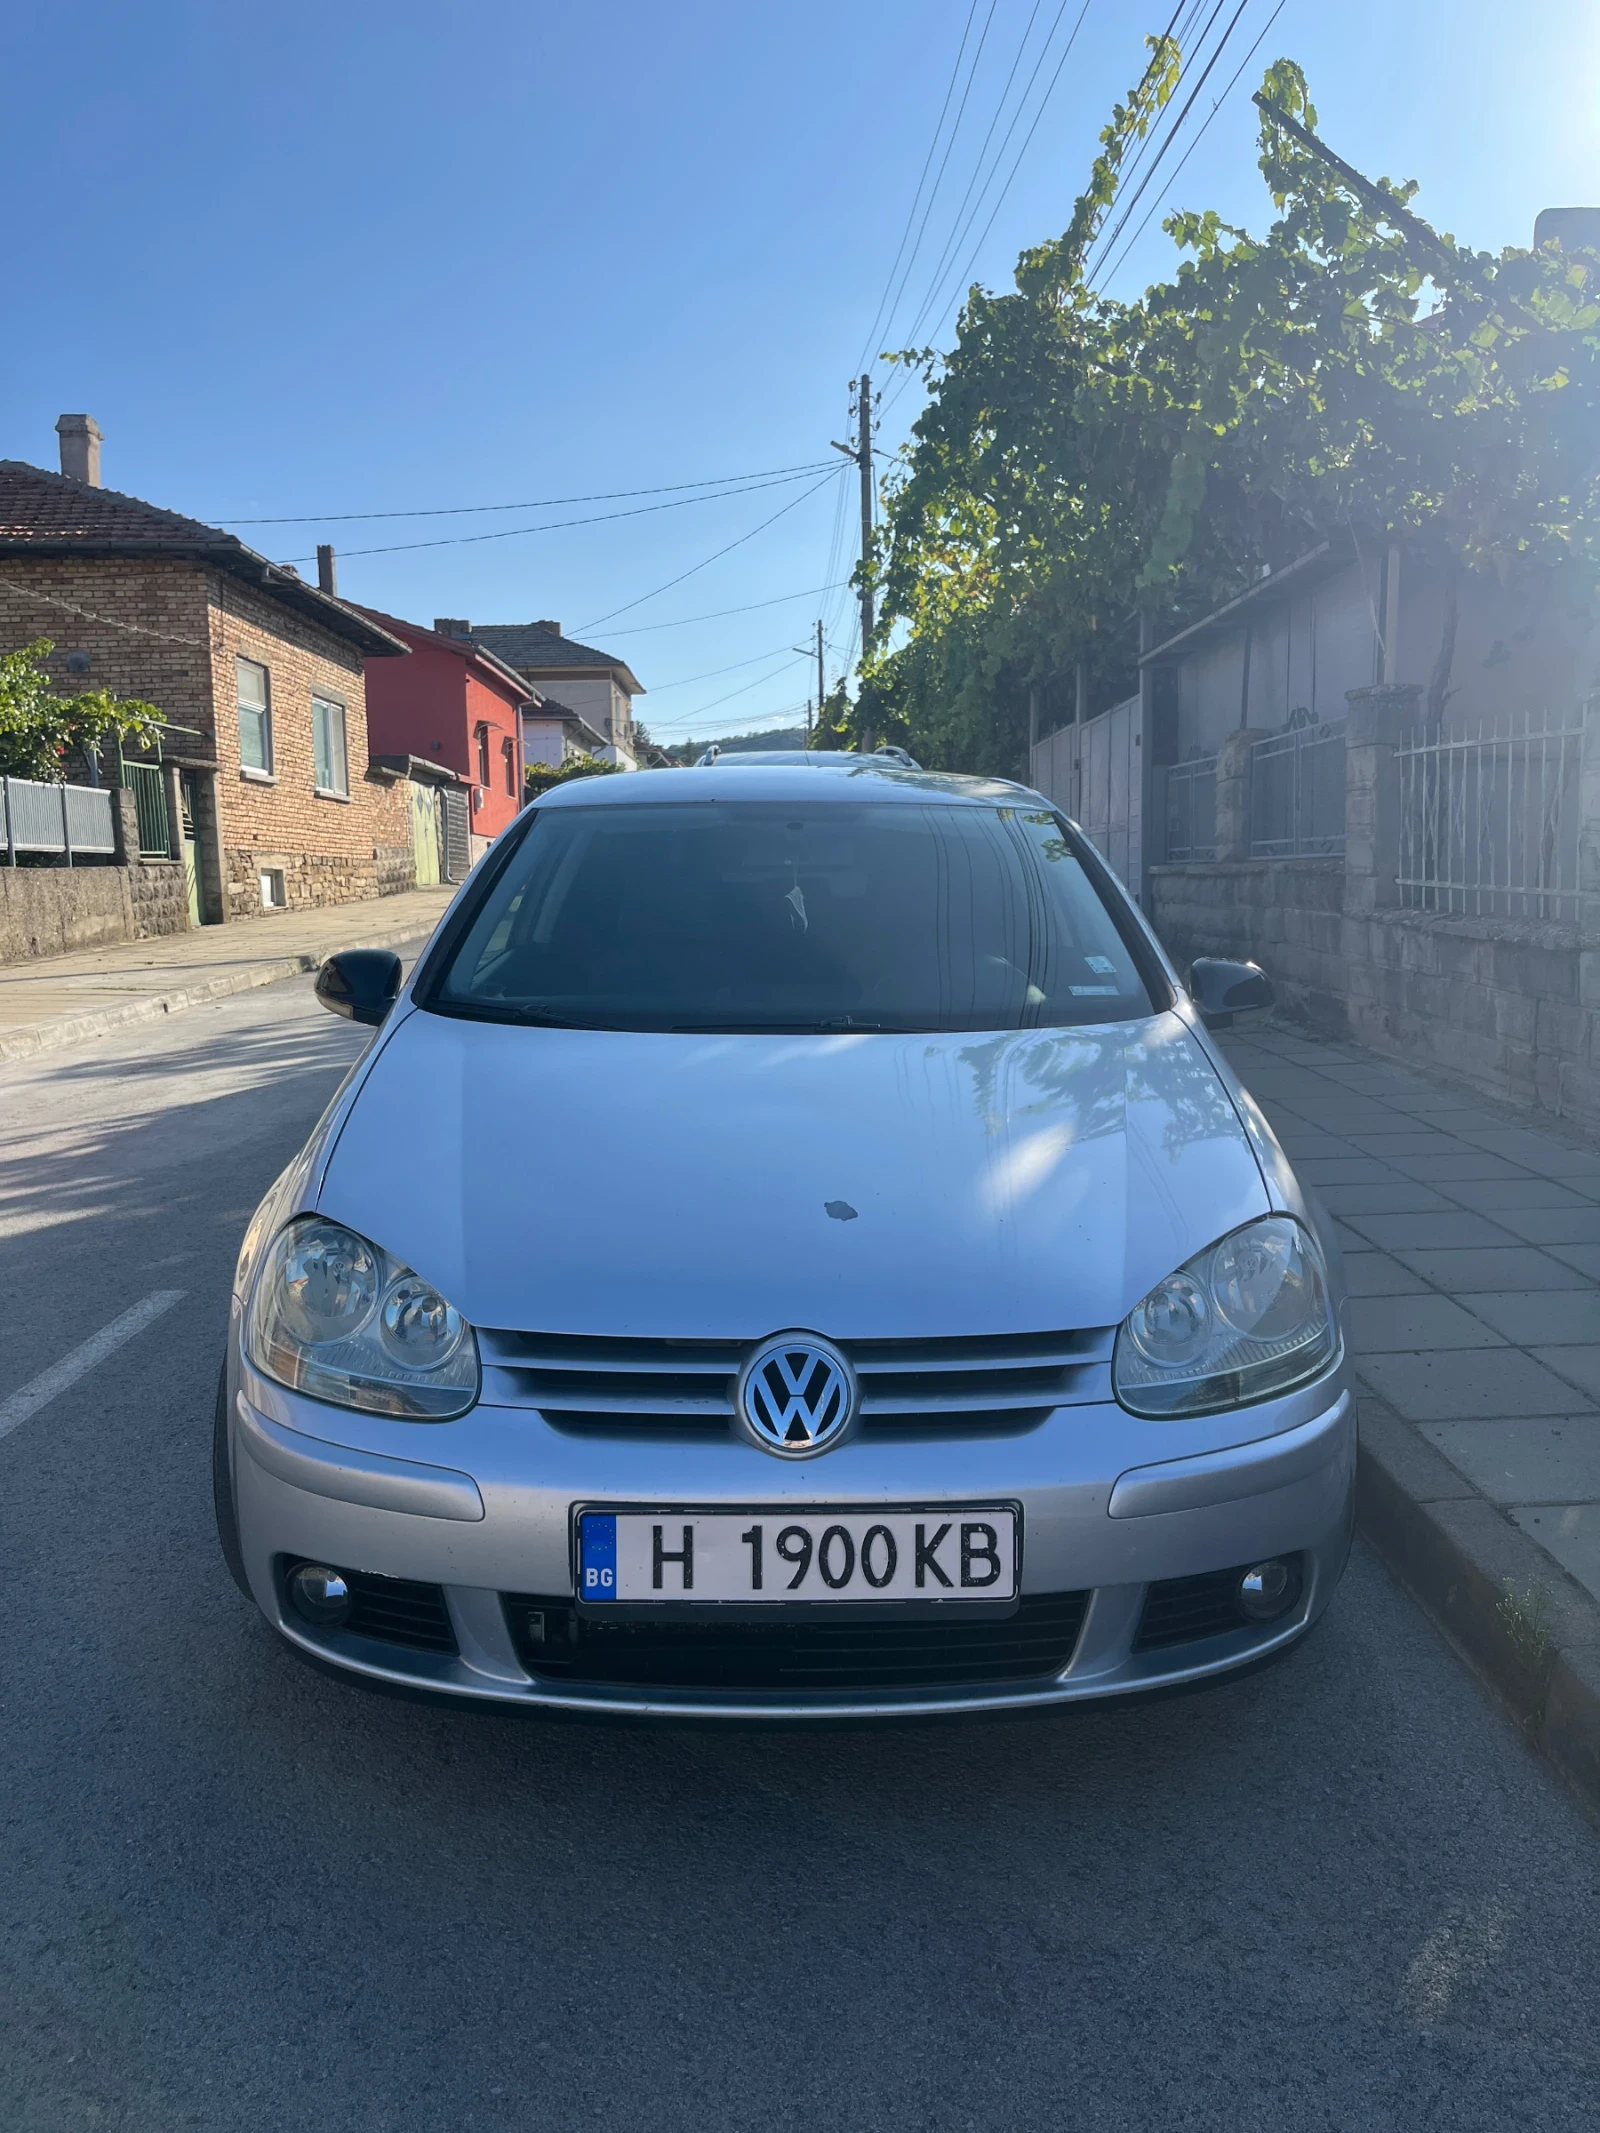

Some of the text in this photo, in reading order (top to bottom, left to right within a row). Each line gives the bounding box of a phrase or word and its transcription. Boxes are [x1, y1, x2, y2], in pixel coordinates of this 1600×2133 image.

[585, 1567, 614, 1588] BG
[652, 1523, 1001, 1590] H 1900 KB
